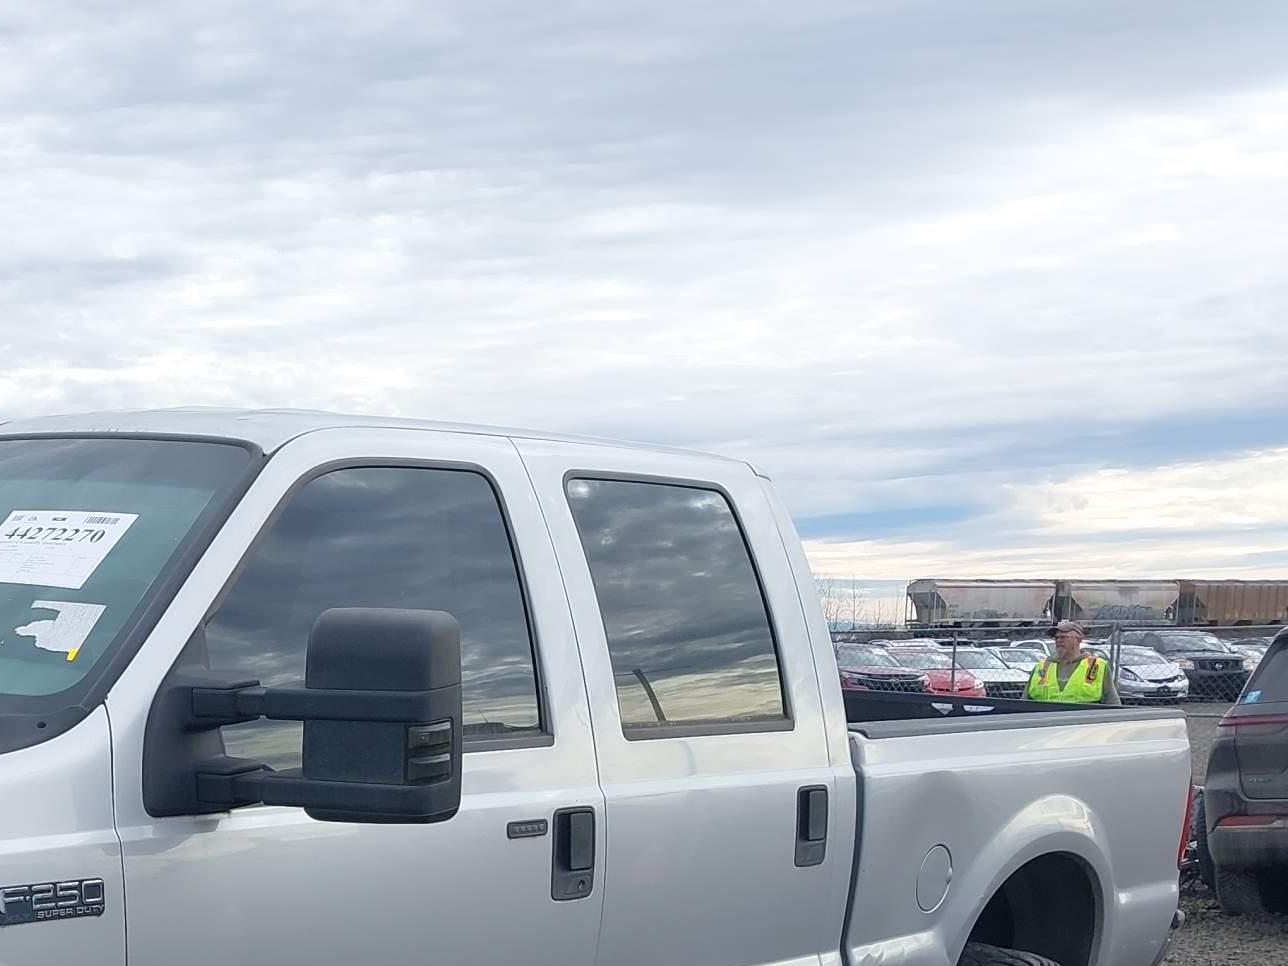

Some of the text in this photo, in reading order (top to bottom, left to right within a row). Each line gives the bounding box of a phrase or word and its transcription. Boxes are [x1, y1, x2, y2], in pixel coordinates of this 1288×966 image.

[5, 526, 106, 543] 44272270
[37, 904, 105, 919] SUPER DUTY
